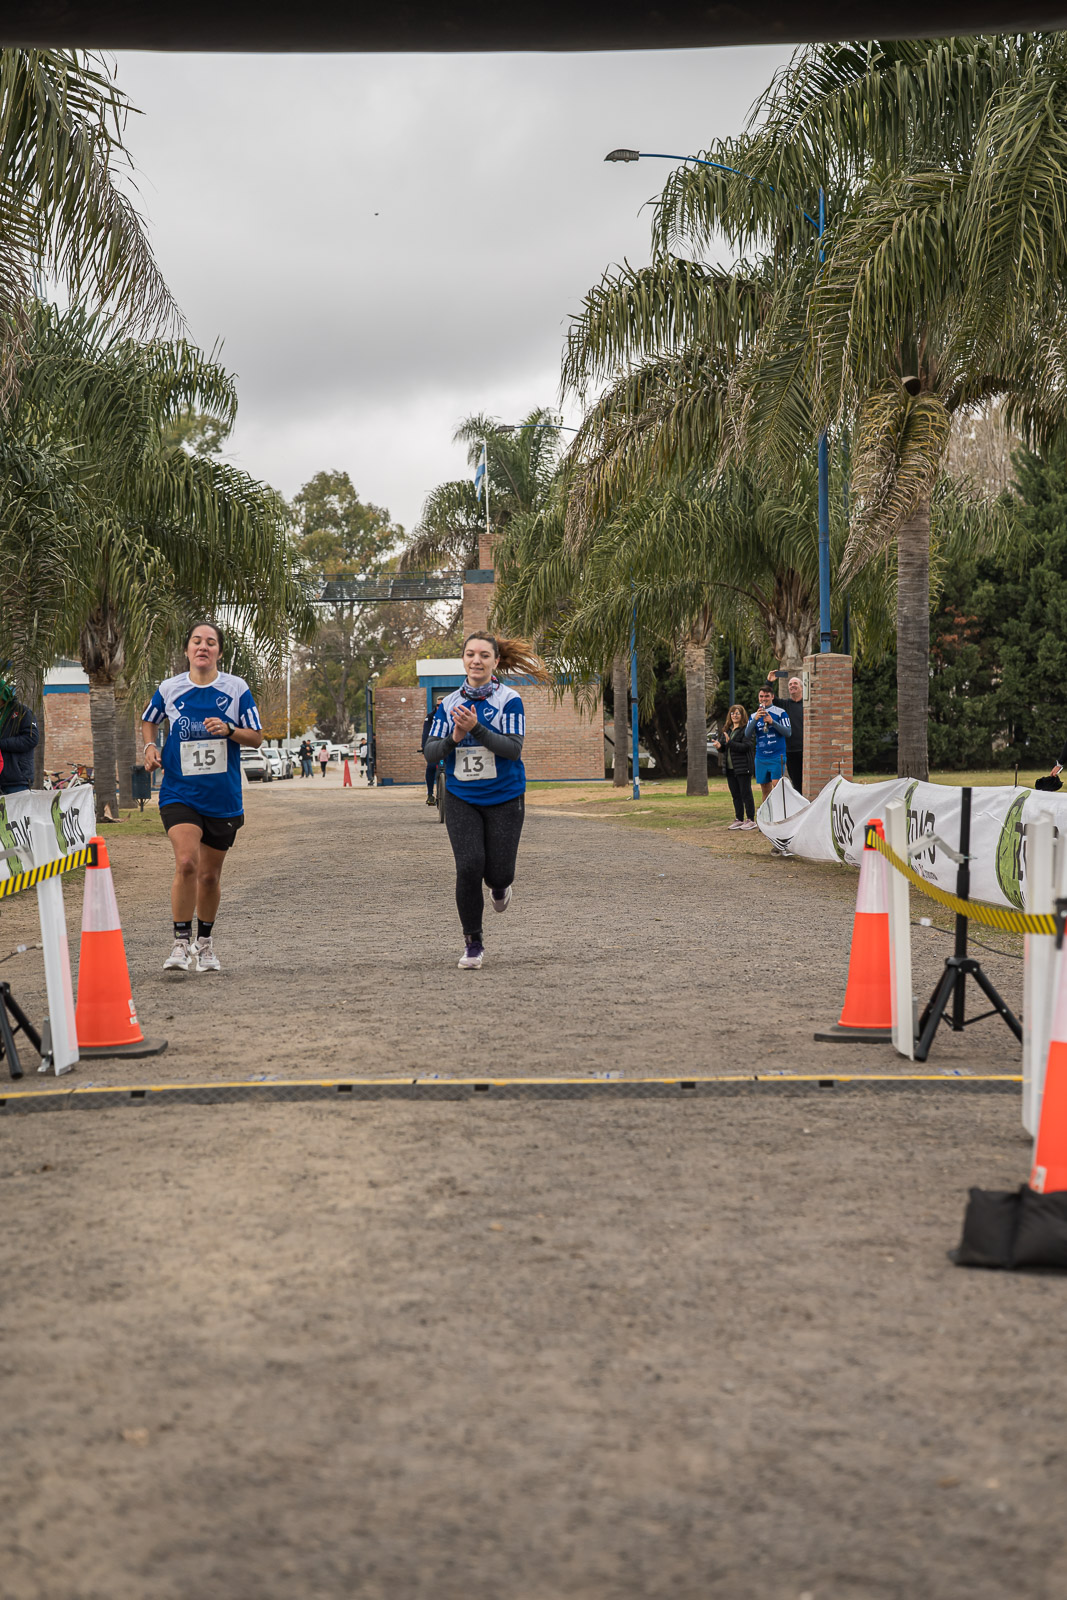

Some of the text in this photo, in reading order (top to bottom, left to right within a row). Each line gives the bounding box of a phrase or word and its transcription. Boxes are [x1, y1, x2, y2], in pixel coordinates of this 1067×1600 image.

[178, 716, 191, 741] 3
[192, 749, 216, 767] 15
[462, 756, 484, 773] 13
